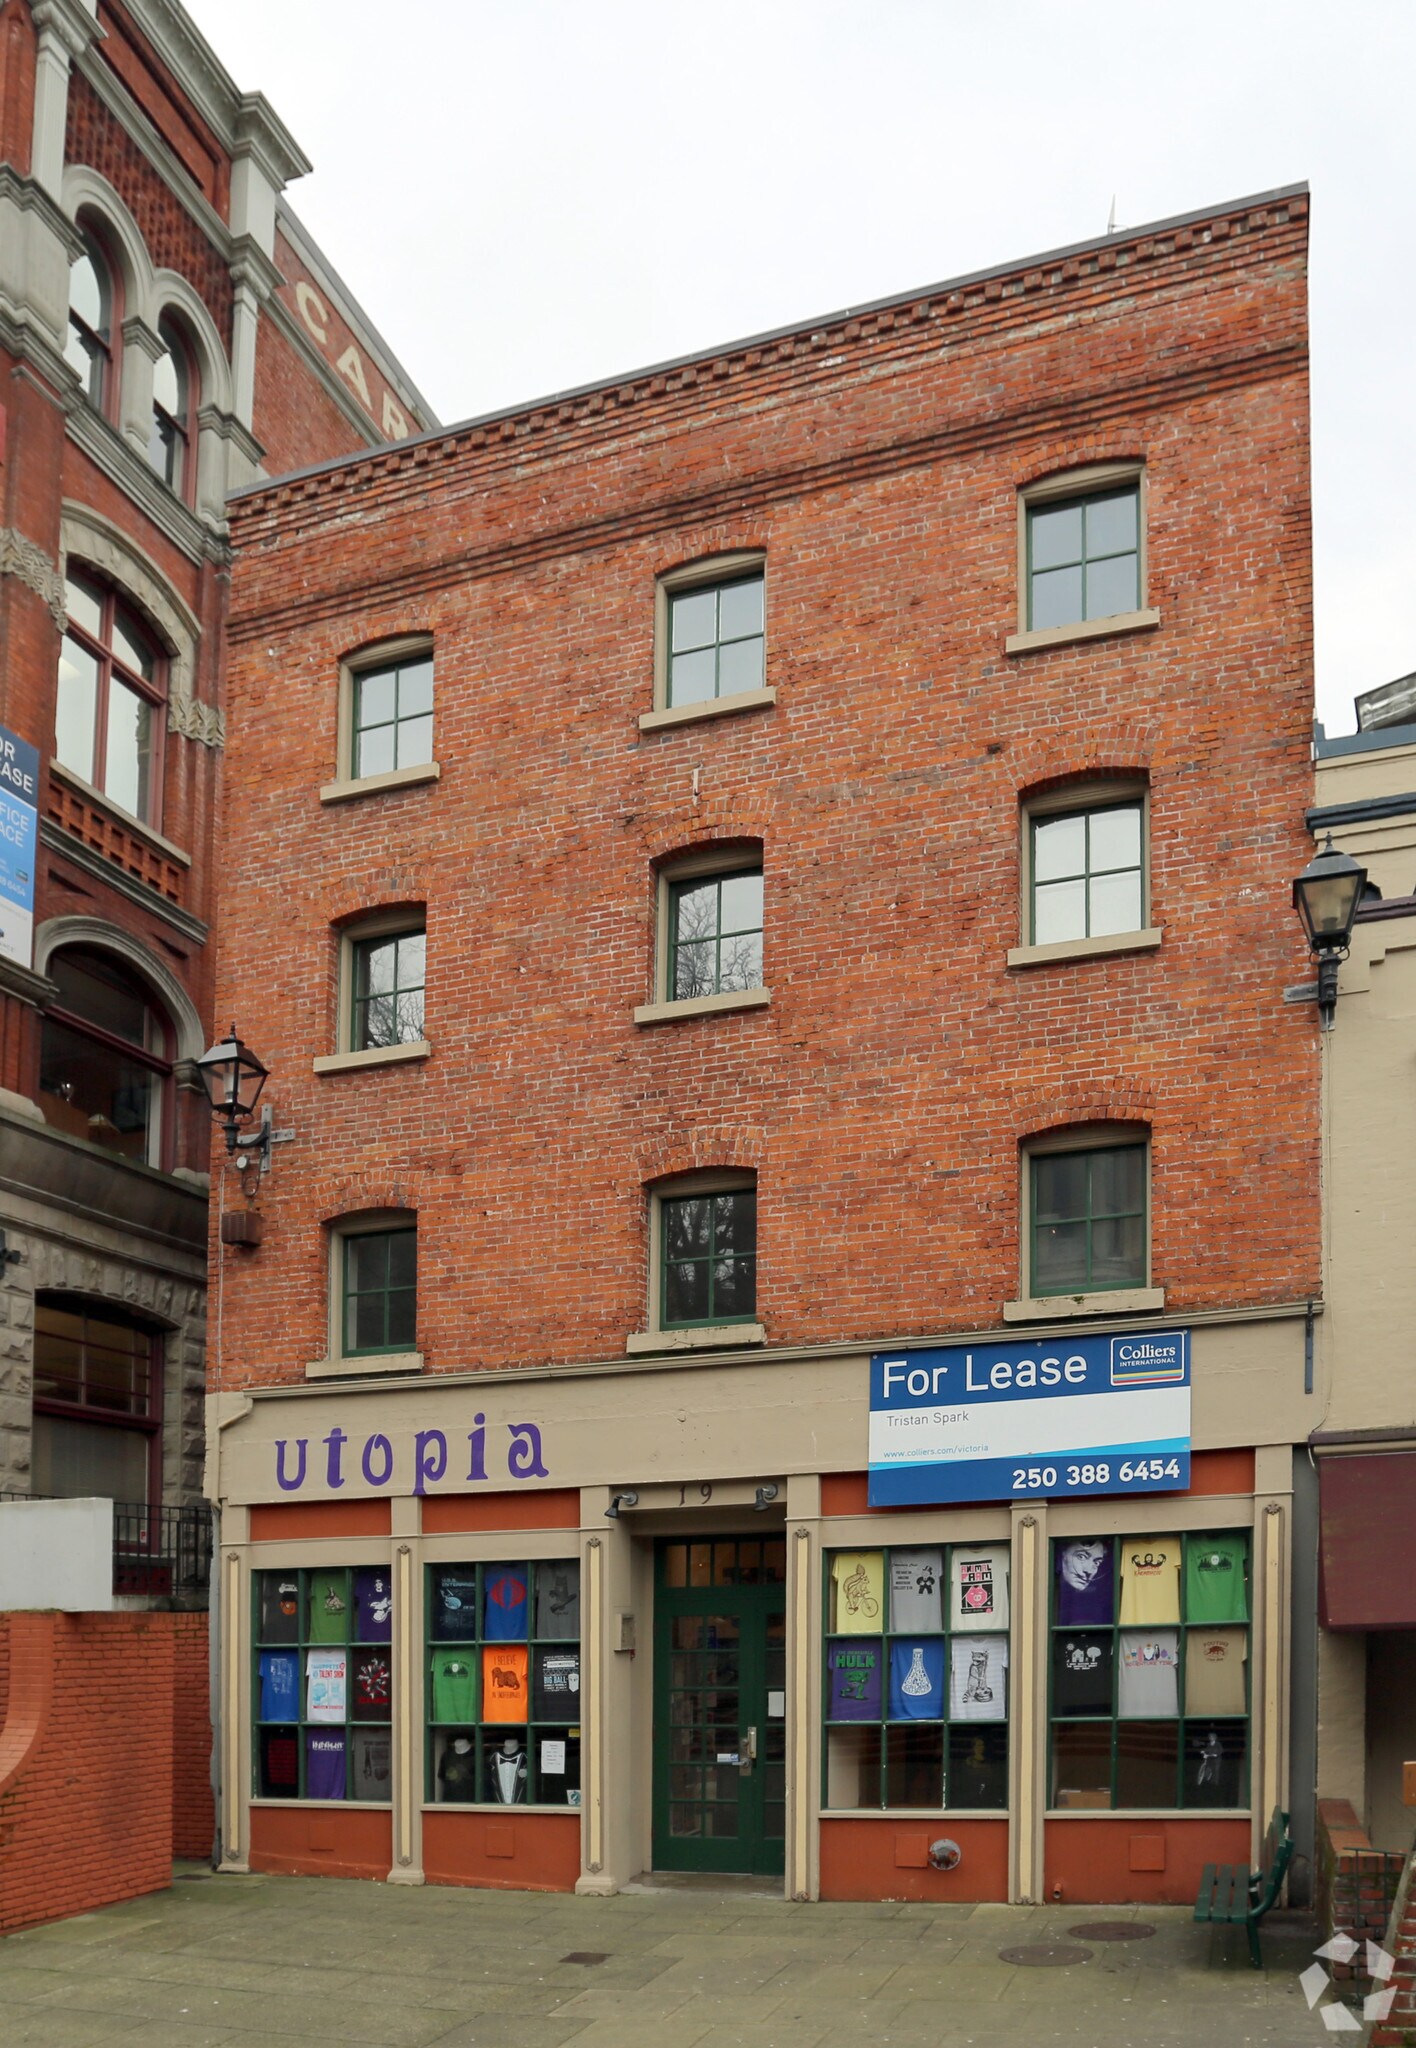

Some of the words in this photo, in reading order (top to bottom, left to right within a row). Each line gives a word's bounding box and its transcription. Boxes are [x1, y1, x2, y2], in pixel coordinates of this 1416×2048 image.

[1119, 1344, 1176, 1361] Colliers
[1119, 1357, 1176, 1367] INTERNATIONAL
[883, 1360, 948, 1398] For
[965, 1354, 1087, 1392] Lease
[887, 1415, 929, 1427] Tristan
[933, 1411, 969, 1425] Spark
[275, 1412, 549, 1496] utopia
[883, 1443, 989, 1458] www.colliers.com/victoria
[1012, 1467, 1057, 1490] 250
[1066, 1463, 1110, 1486] 388
[1119, 1458, 1180, 1482] 6454
[679, 1482, 713, 1506] 19
[836, 1655, 876, 1668] HULK
